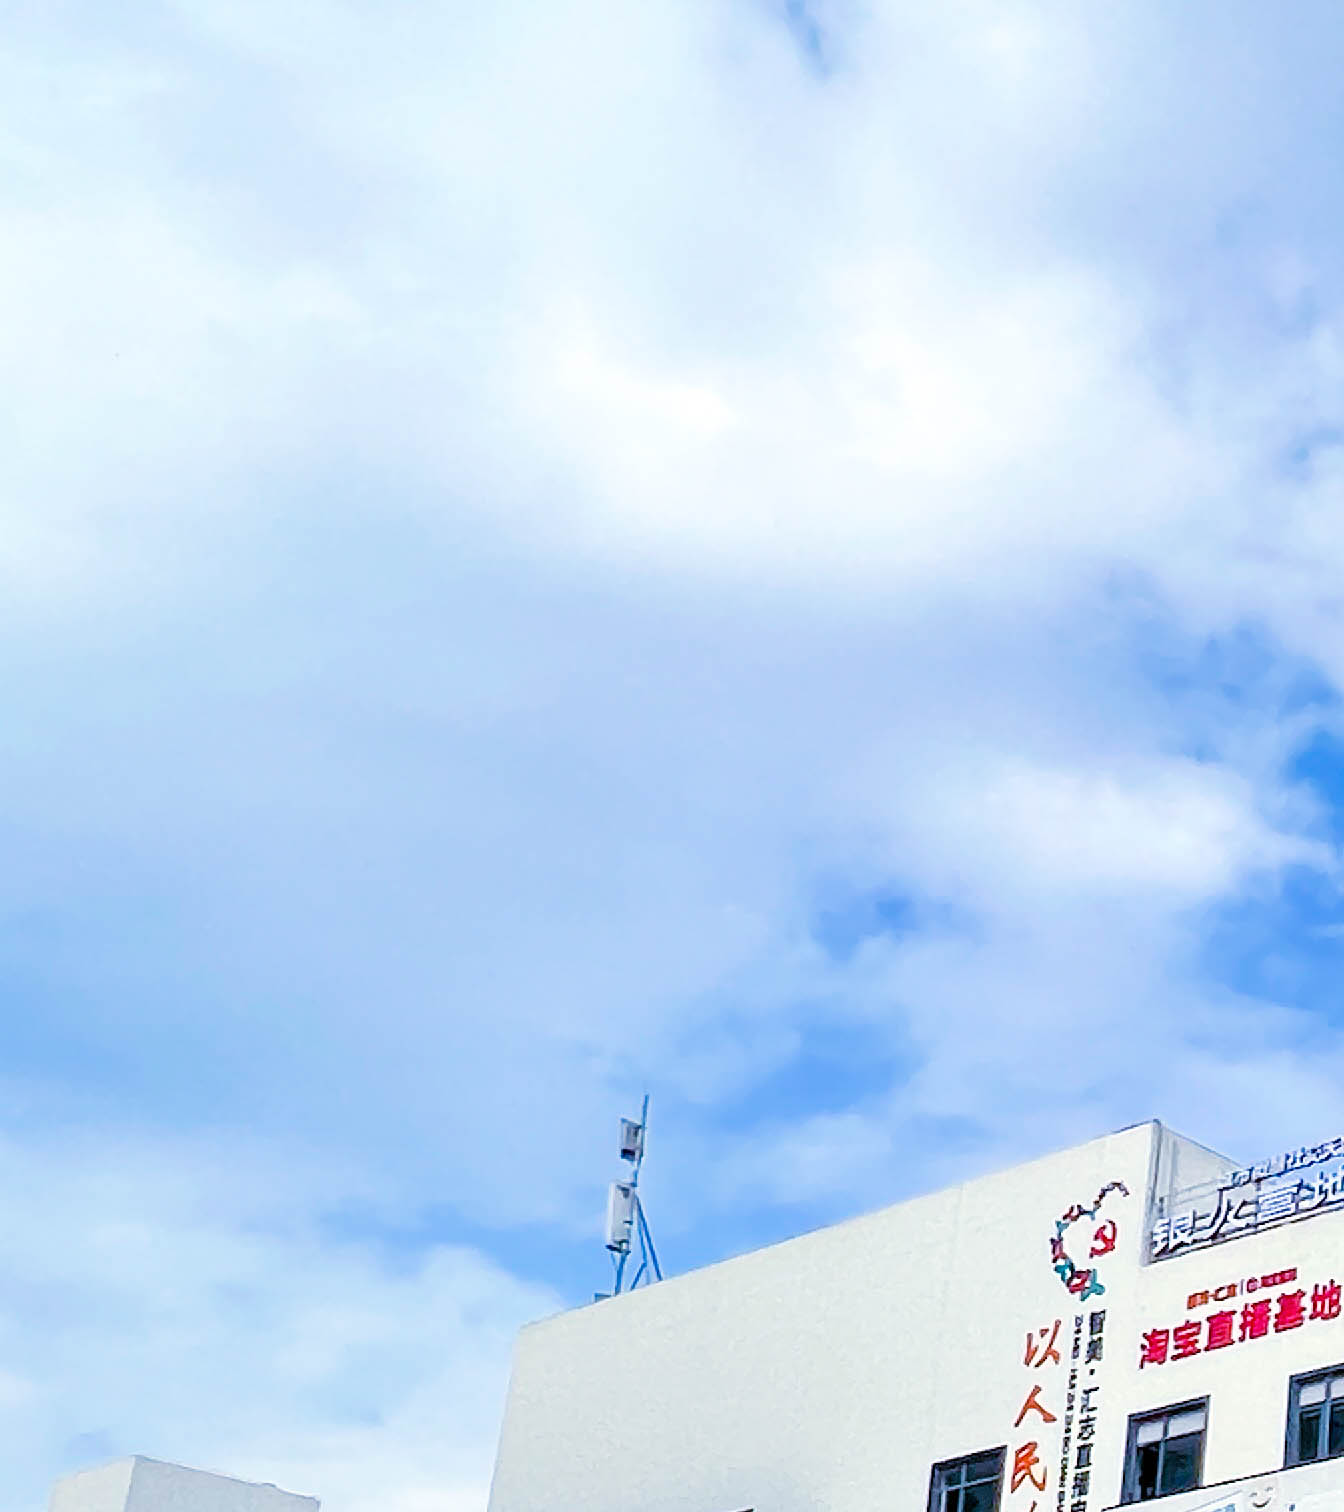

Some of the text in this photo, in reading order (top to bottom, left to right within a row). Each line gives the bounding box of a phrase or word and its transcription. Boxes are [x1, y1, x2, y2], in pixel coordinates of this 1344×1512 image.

[1138, 1279, 1342, 1370] 淘宝直播基地
